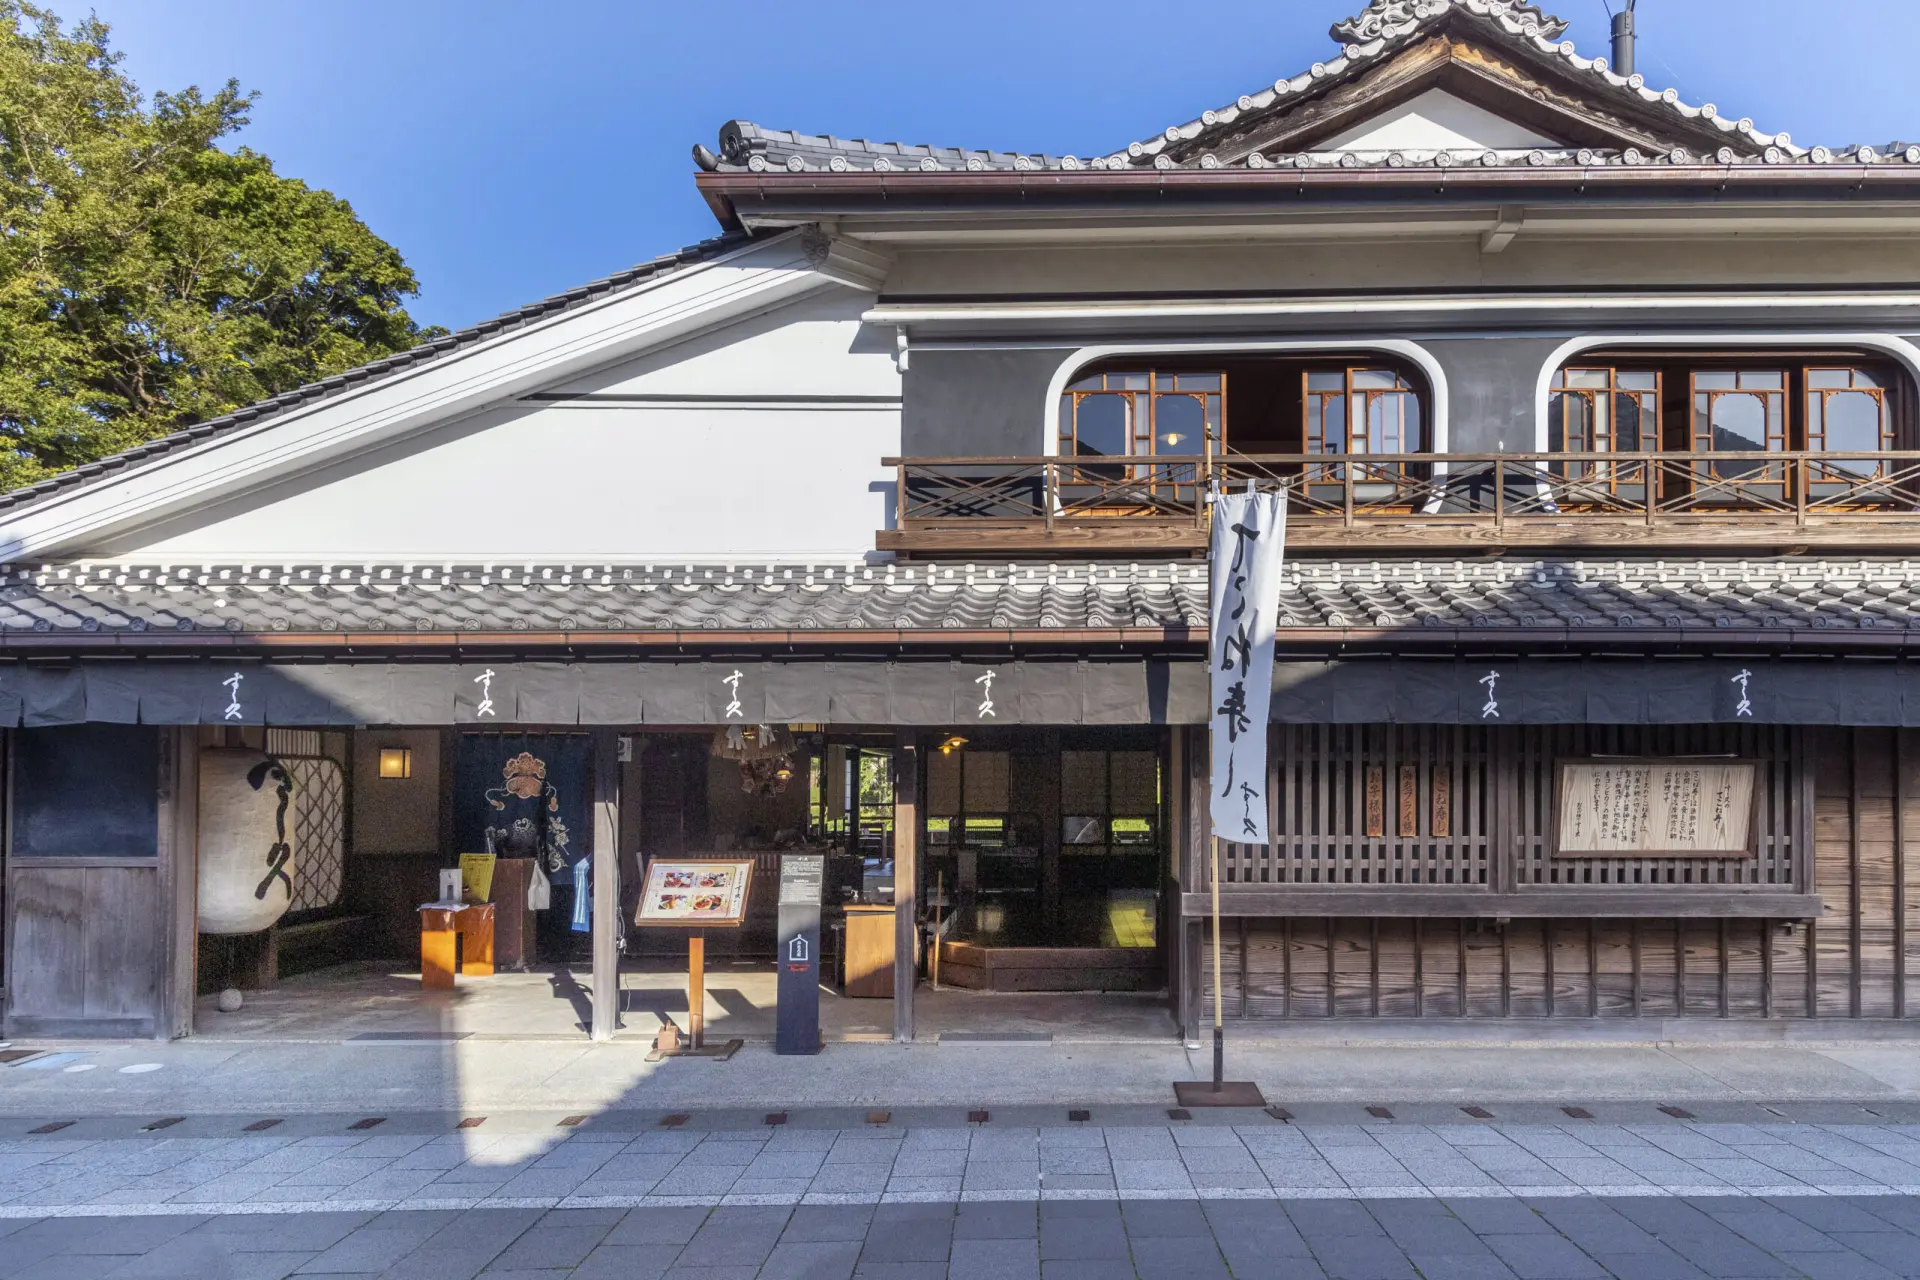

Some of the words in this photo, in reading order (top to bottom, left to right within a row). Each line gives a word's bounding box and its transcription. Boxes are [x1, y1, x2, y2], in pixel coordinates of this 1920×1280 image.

[222, 672, 244, 720] すし久
[473, 668, 496, 717] すし久
[722, 669, 744, 719] すし久
[975, 669, 996, 719] すし久
[1479, 670, 1500, 718] すし久
[1730, 668, 1753, 717] すし久
